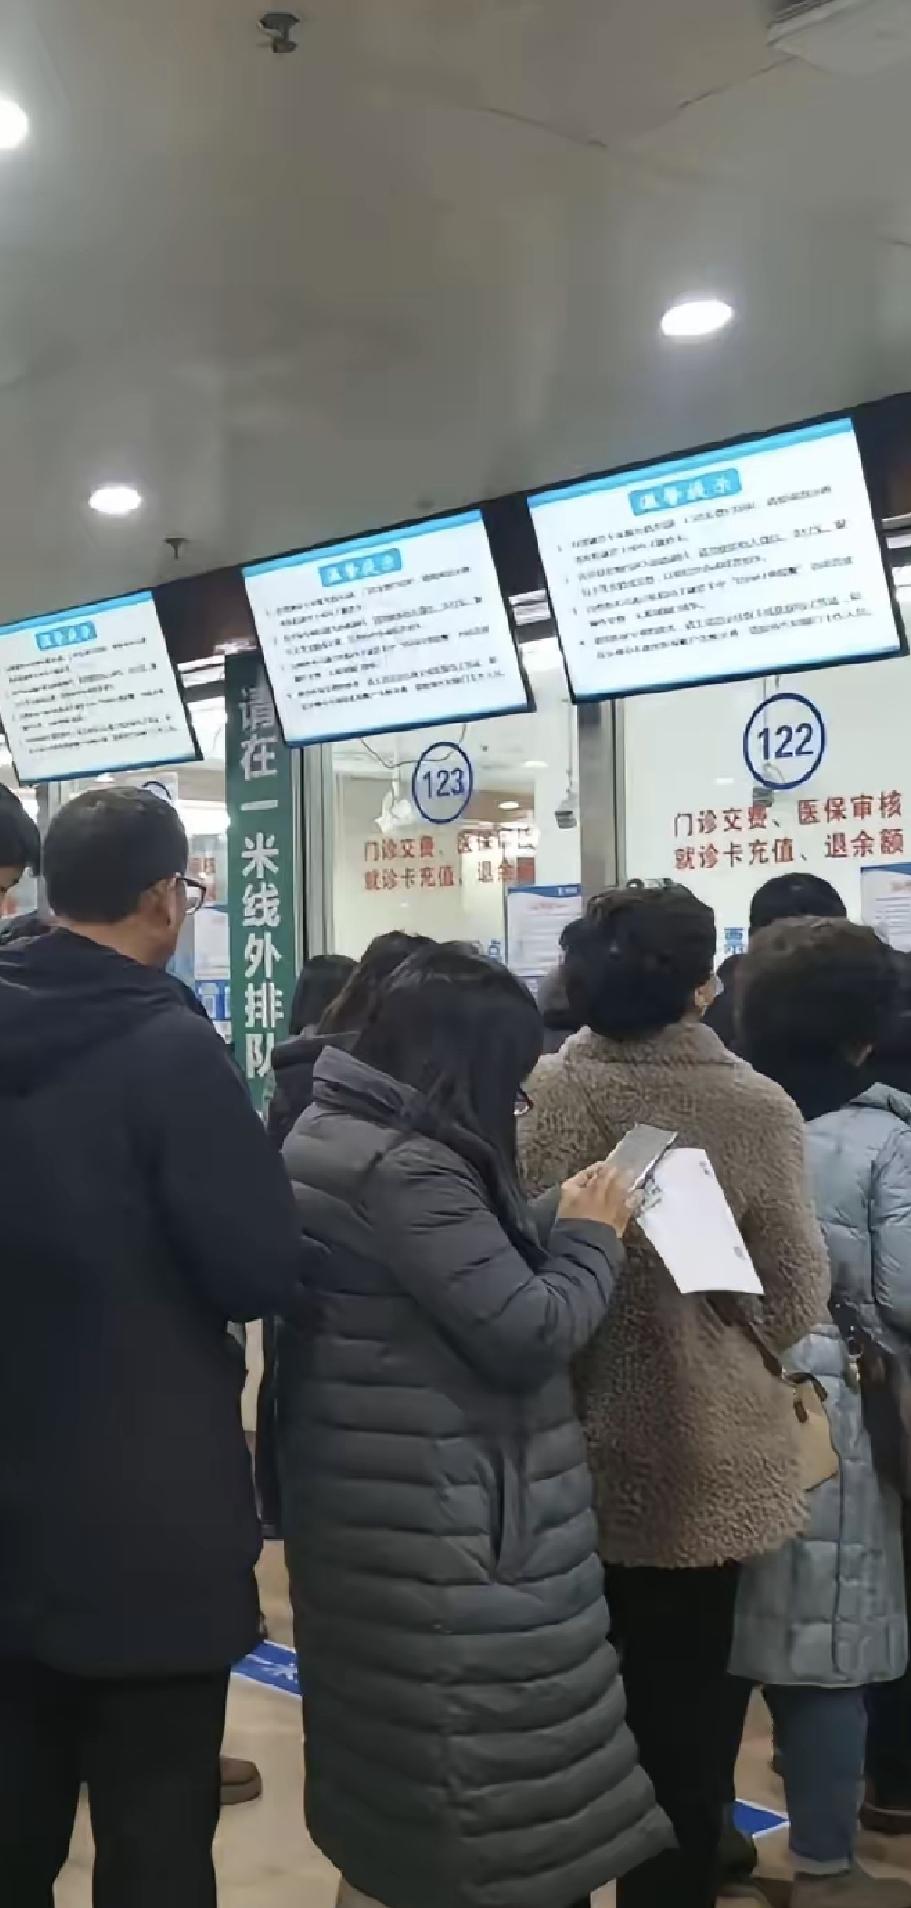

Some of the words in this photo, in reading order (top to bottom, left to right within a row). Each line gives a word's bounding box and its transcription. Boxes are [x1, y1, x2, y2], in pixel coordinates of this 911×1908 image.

[757, 722, 814, 760] 122
[422, 767, 466, 799] 123
[673, 789, 902, 837] 门诊交费、医保审核
[674, 828, 904, 870] 就诊卡充值、退余额
[239, 687, 284, 1079] 请在一米线外排队
